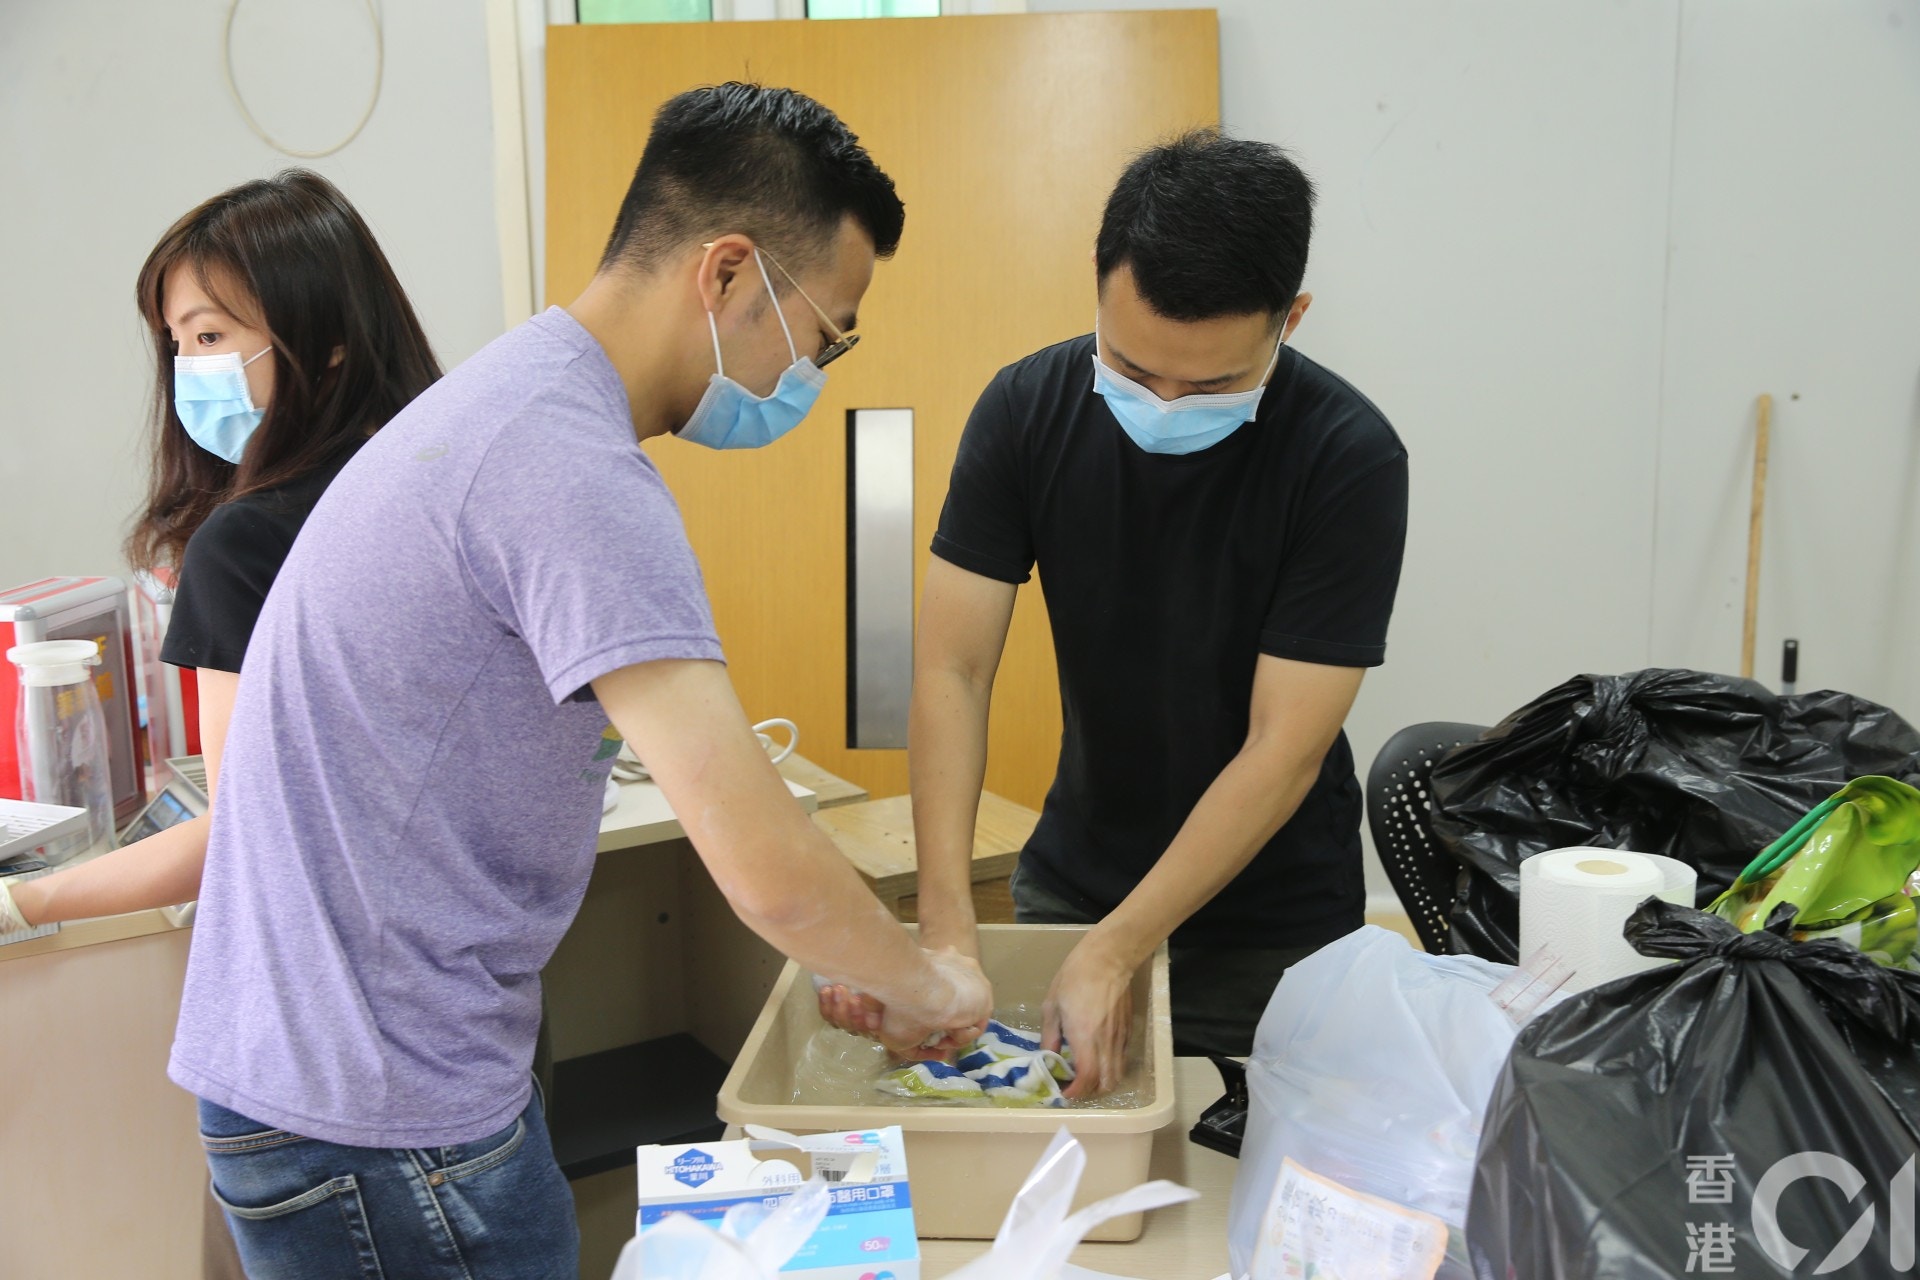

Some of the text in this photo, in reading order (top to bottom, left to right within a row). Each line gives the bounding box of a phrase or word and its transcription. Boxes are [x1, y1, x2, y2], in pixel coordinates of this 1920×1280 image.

[664, 1162, 724, 1175] HITOHAKAWA
[762, 1171, 801, 1186] 外科用
[864, 1240, 880, 1251] 50
